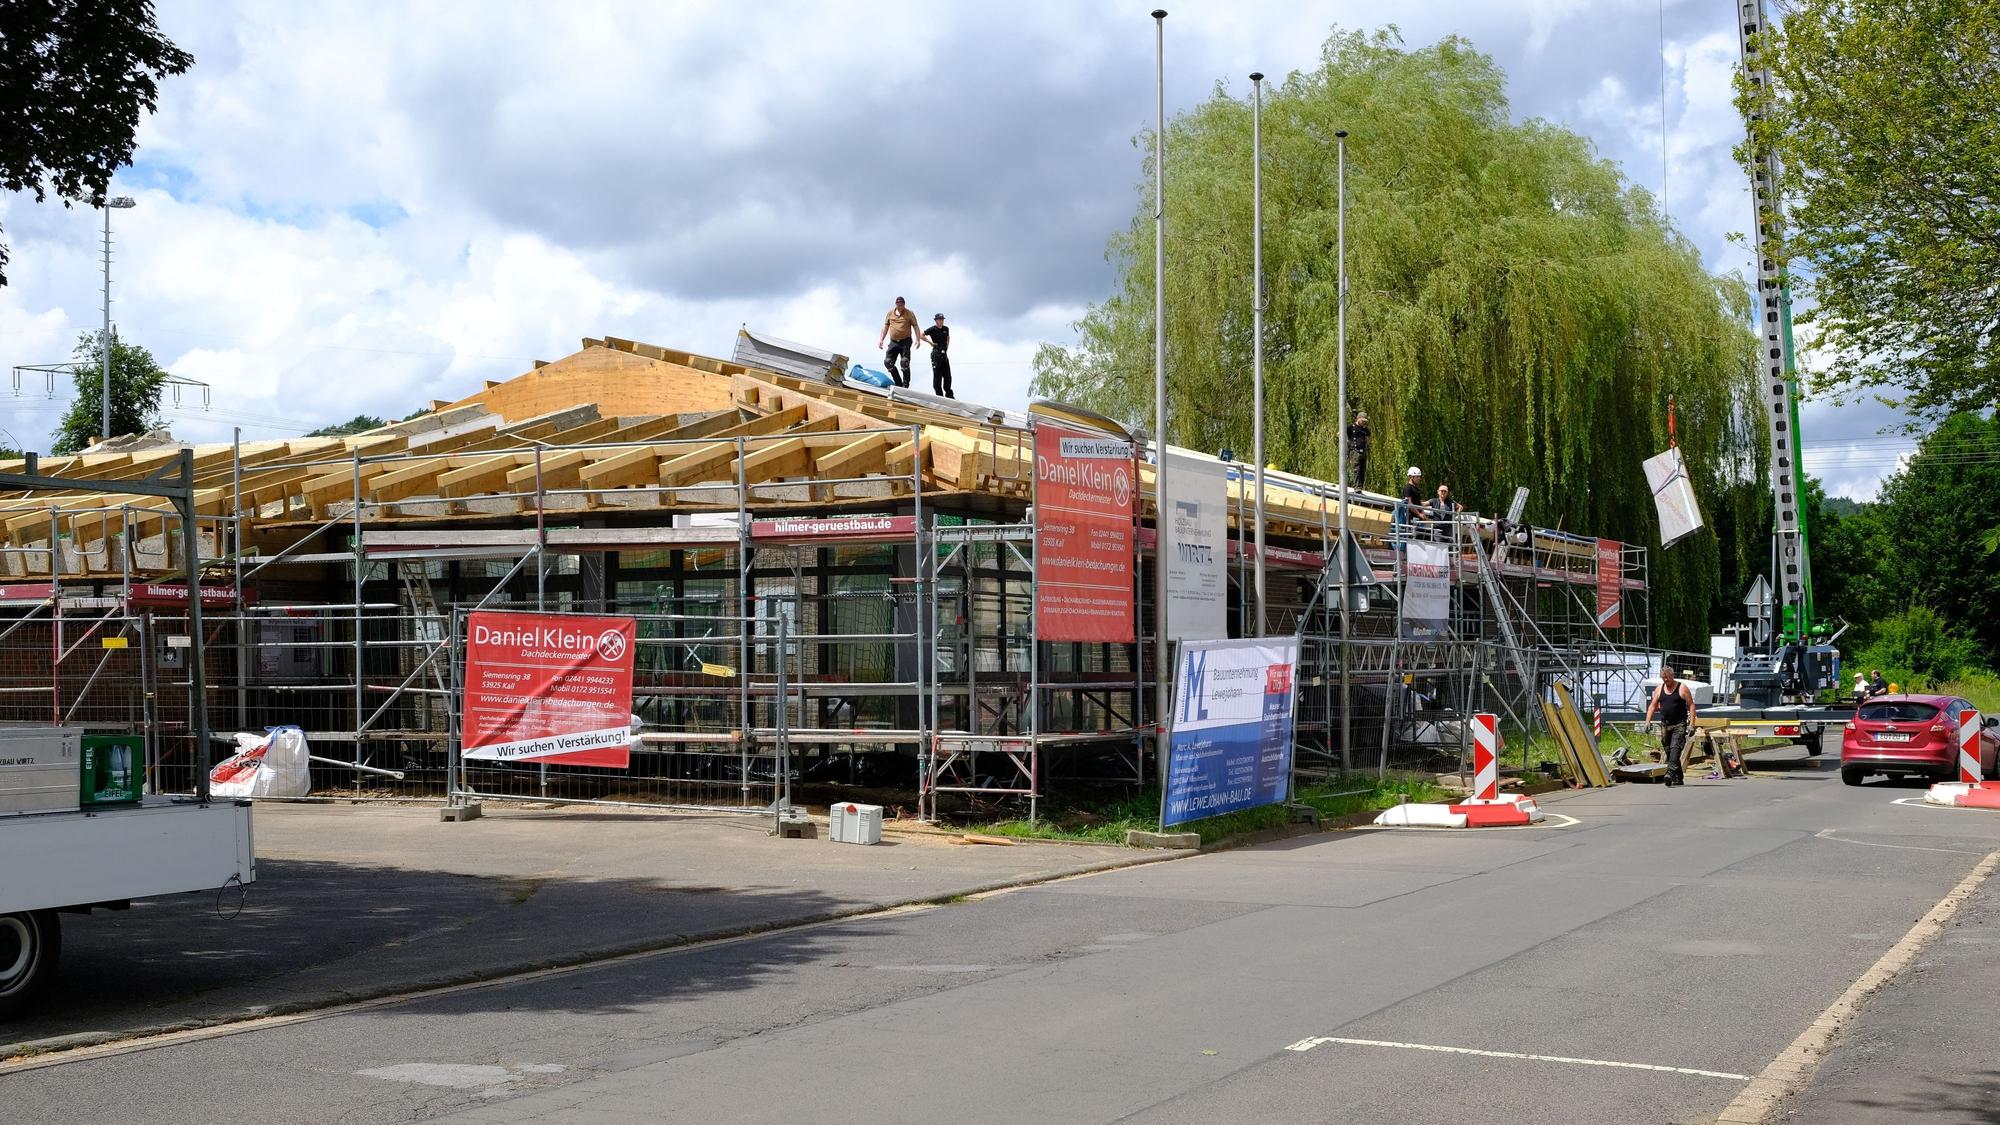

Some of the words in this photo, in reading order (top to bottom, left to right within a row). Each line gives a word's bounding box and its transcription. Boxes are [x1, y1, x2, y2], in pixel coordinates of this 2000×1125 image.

[1062, 442, 1073, 453] Wir
[1038, 455, 1079, 486] Daniel
[1081, 463, 1112, 491] Klein
[775, 519, 892, 533] hilmer-geruestbau.de
[148, 585, 237, 598] hilmer-geestbau.de
[475, 626, 539, 647] Daniel
[543, 629, 594, 650] Klein
[521, 649, 592, 660] Dachdeckermeister
[482, 671, 521, 681] Siemensring
[497, 746, 515, 758] Wir
[518, 741, 555, 755] suchen
[557, 730, 626, 749] Verstärkung!
[85, 747, 94, 769] EIFEL
[104, 789, 123, 797] EIFEL
[1171, 788, 1252, 815] WWW.LEWEJOHANN-BAU.DE
